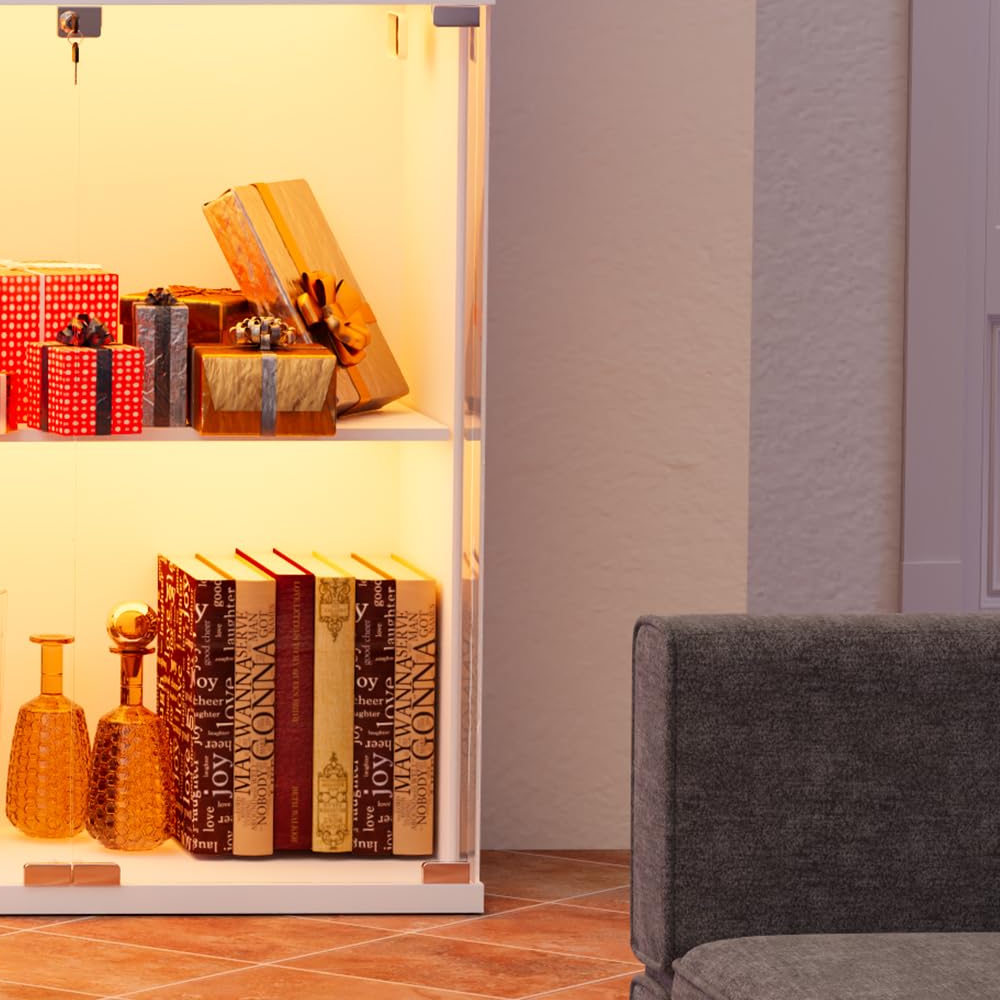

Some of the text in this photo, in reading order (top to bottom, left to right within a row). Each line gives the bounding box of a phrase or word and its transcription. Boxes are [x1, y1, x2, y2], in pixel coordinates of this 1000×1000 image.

[235, 657, 251, 738] WANNA
[251, 639, 275, 760] GONNA
[395, 657, 412, 738] WANNA
[411, 639, 435, 760] GONNA
[203, 752, 233, 799] joy
[234, 741, 251, 795] MAY
[363, 752, 393, 799] joy
[394, 741, 411, 795] MAY
[203, 806, 215, 832] love
[257, 769, 268, 825] NOBODY
[363, 806, 375, 832] love
[417, 769, 428, 825] NOBODY
